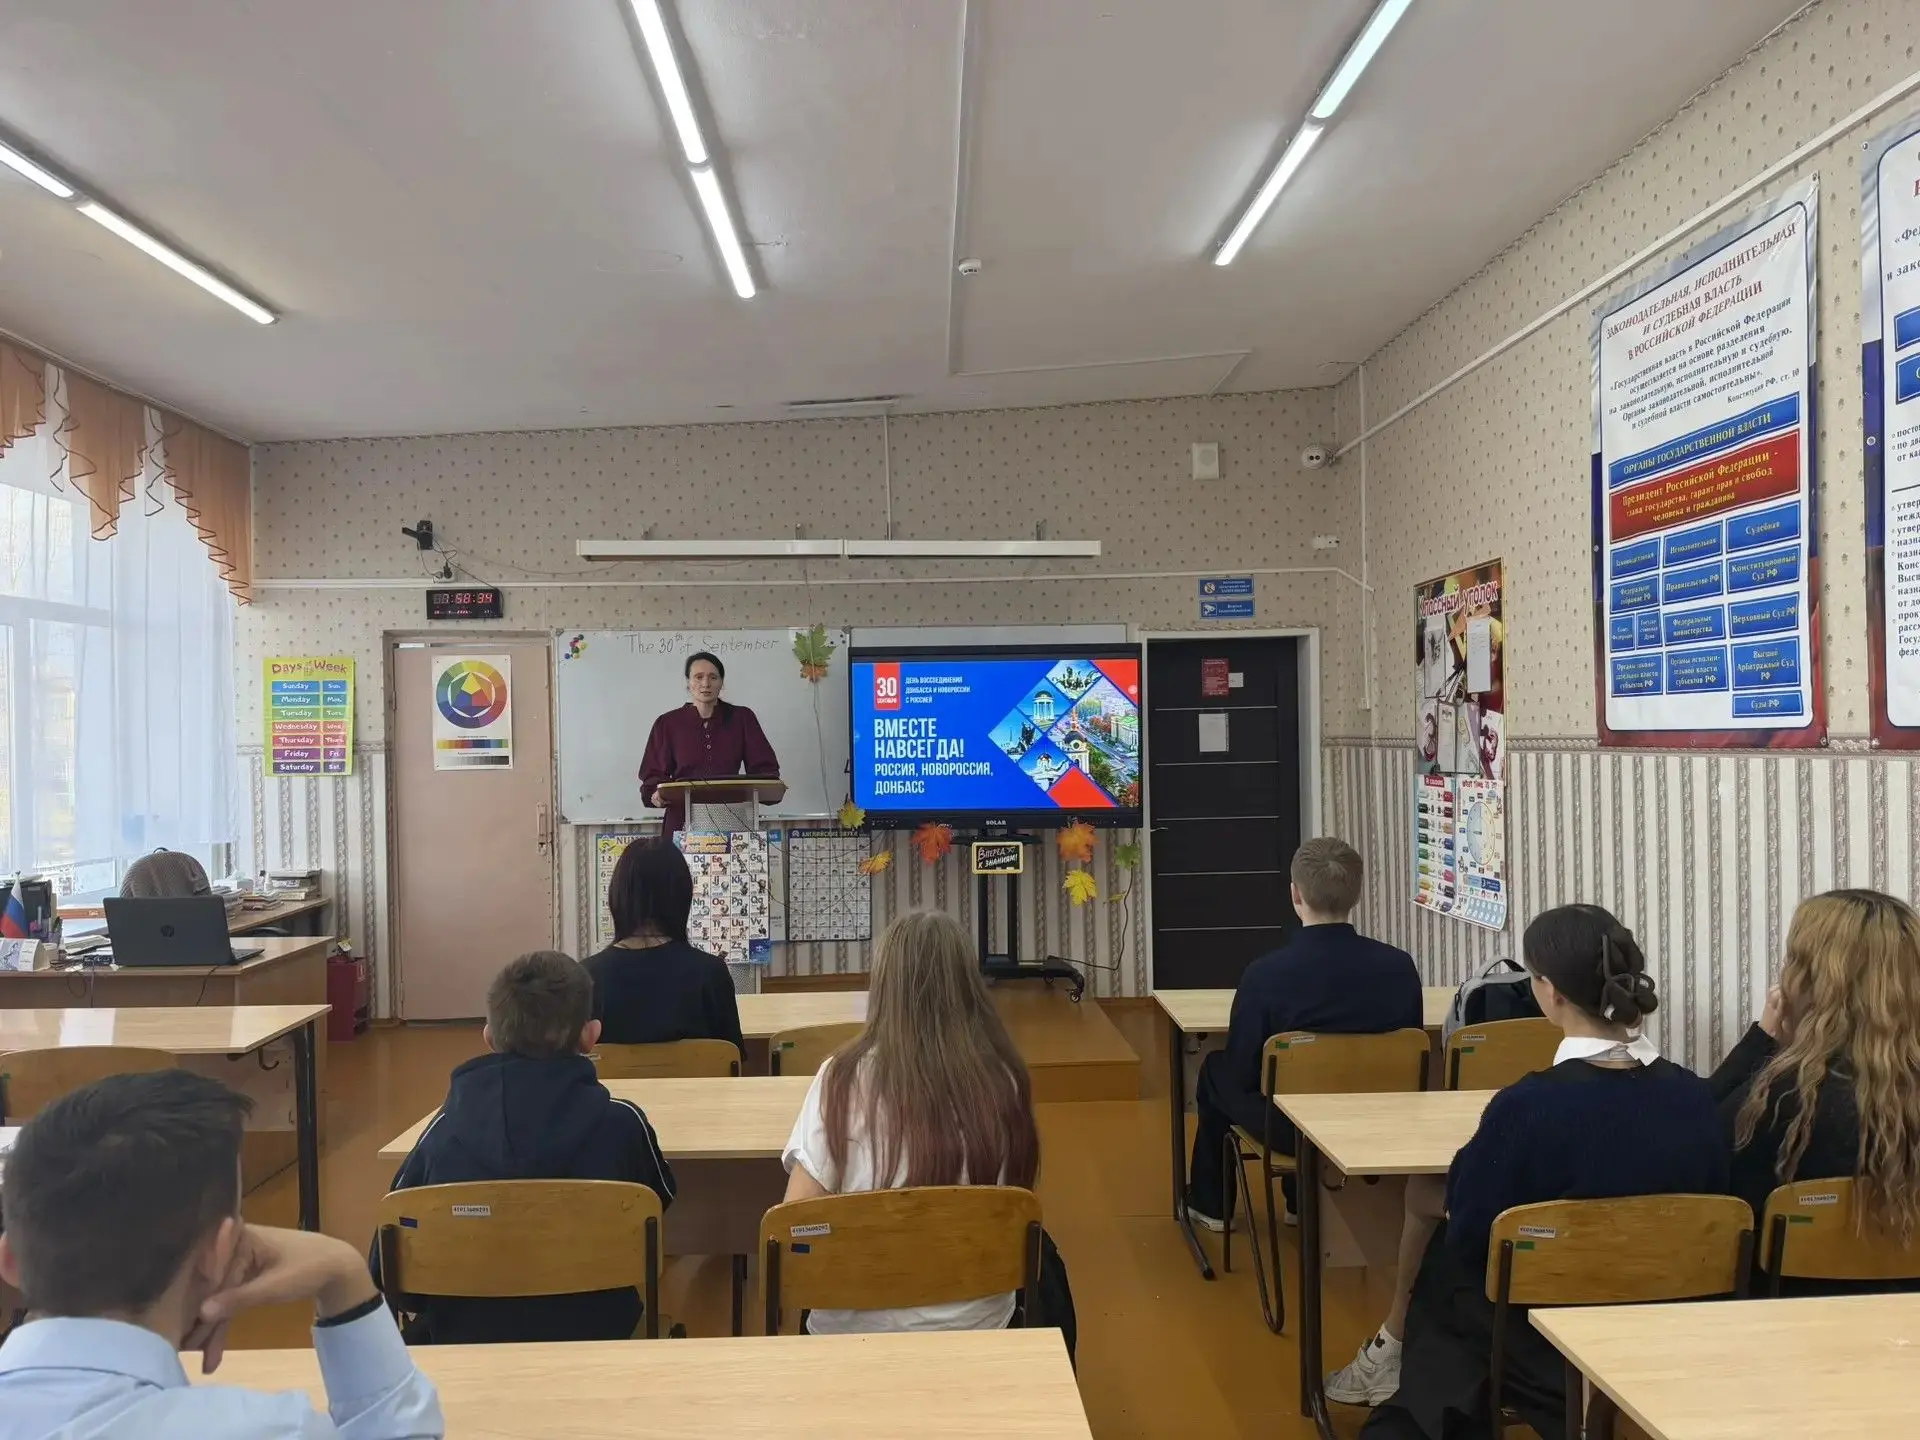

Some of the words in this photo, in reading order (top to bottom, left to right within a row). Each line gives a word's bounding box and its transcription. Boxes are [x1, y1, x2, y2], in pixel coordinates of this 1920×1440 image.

[1606, 284, 1691, 340] ЗАКОНОДАТЕЛЬНАЯ,
[1694, 222, 1796, 291] ИСПОЛНИТЕЛЬНАЯ
[1642, 323, 1650, 335] И
[1653, 295, 1701, 331] СУДЕБНАЯ
[1704, 274, 1742, 305] ВЛАСТЬ
[1627, 349, 1634, 360] В
[1634, 316, 1695, 357] РОССИЙСКОЙ
[1698, 280, 1763, 323] ФЕДЕРАЦИИ
[1665, 348, 1686, 365] власть
[1695, 320, 1741, 349] Российской
[1743, 297, 1791, 325] Федерации
[1629, 366, 1677, 395] осуществляется
[1678, 361, 1687, 371] на
[1689, 348, 1714, 366] основе
[1716, 325, 1765, 356] разделения
[1608, 406, 1617, 415] на
[1676, 351, 1739, 386] исполнительную
[1741, 347, 1747, 356] и
[1622, 405, 1646, 422] Органы
[1709, 346, 1774, 383] исполнительной
[1727, 384, 1764, 404] Конституция
[1792, 368, 1800, 378] 10
[1638, 408, 1667, 428] судебной
[1669, 399, 1691, 415] власти
[1623, 457, 1655, 475] ОРГАНЫ
[1657, 426, 1735, 465] ГОСУДАРСТВЕННОЙ
[1737, 412, 1771, 434] ВЛАСТИ
[1897, 441, 1908, 450] по
[1897, 453, 1906, 462] от
[1622, 487, 1664, 508] Президент
[1666, 467, 1714, 493] Российской
[1717, 452, 1770, 476] Федерации
[1626, 508, 1643, 517] глава
[1690, 485, 1714, 500] гарант
[1716, 480, 1733, 492] прав
[1735, 476, 1740, 485] и
[1741, 467, 1774, 482] свобод
[1653, 508, 1684, 521] человека
[1692, 492, 1735, 513] гражданина
[1709, 574, 1720, 583] РФ
[1766, 568, 1778, 578] РФ
[1897, 600, 1908, 609] от
[1732, 612, 1771, 624] Верховный
[1772, 609, 1785, 620] Суд
[1786, 606, 1797, 616] РФ
[624, 632, 654, 654] The
[700, 634, 779, 654] September
[271, 662, 303, 675] Days
[314, 659, 348, 674] Week
[1781, 658, 1795, 669] Суд
[1644, 679, 1655, 688] РФ
[1704, 674, 1717, 684] РФ
[1760, 671, 1771, 680] РФ
[282, 682, 309, 691] Sunday
[876, 676, 898, 697] 30
[905, 686, 932, 694] ДОНБАССА
[281, 696, 311, 704] Monday
[1768, 698, 1780, 707] РФ
[281, 708, 312, 718] Tuesday
[275, 722, 317, 731] Wednesday
[874, 717, 937, 739] ВМЕСТЕ
[279, 736, 315, 745] Thursday
[284, 750, 309, 759] Friday
[874, 739, 965, 761] НАВСЕГДА!
[280, 763, 314, 772] Saturday
[874, 763, 919, 778] РОССИЯ,
[921, 761, 994, 777] НОВОРОССИЯ,
[874, 780, 925, 796] ДОНБАСС
